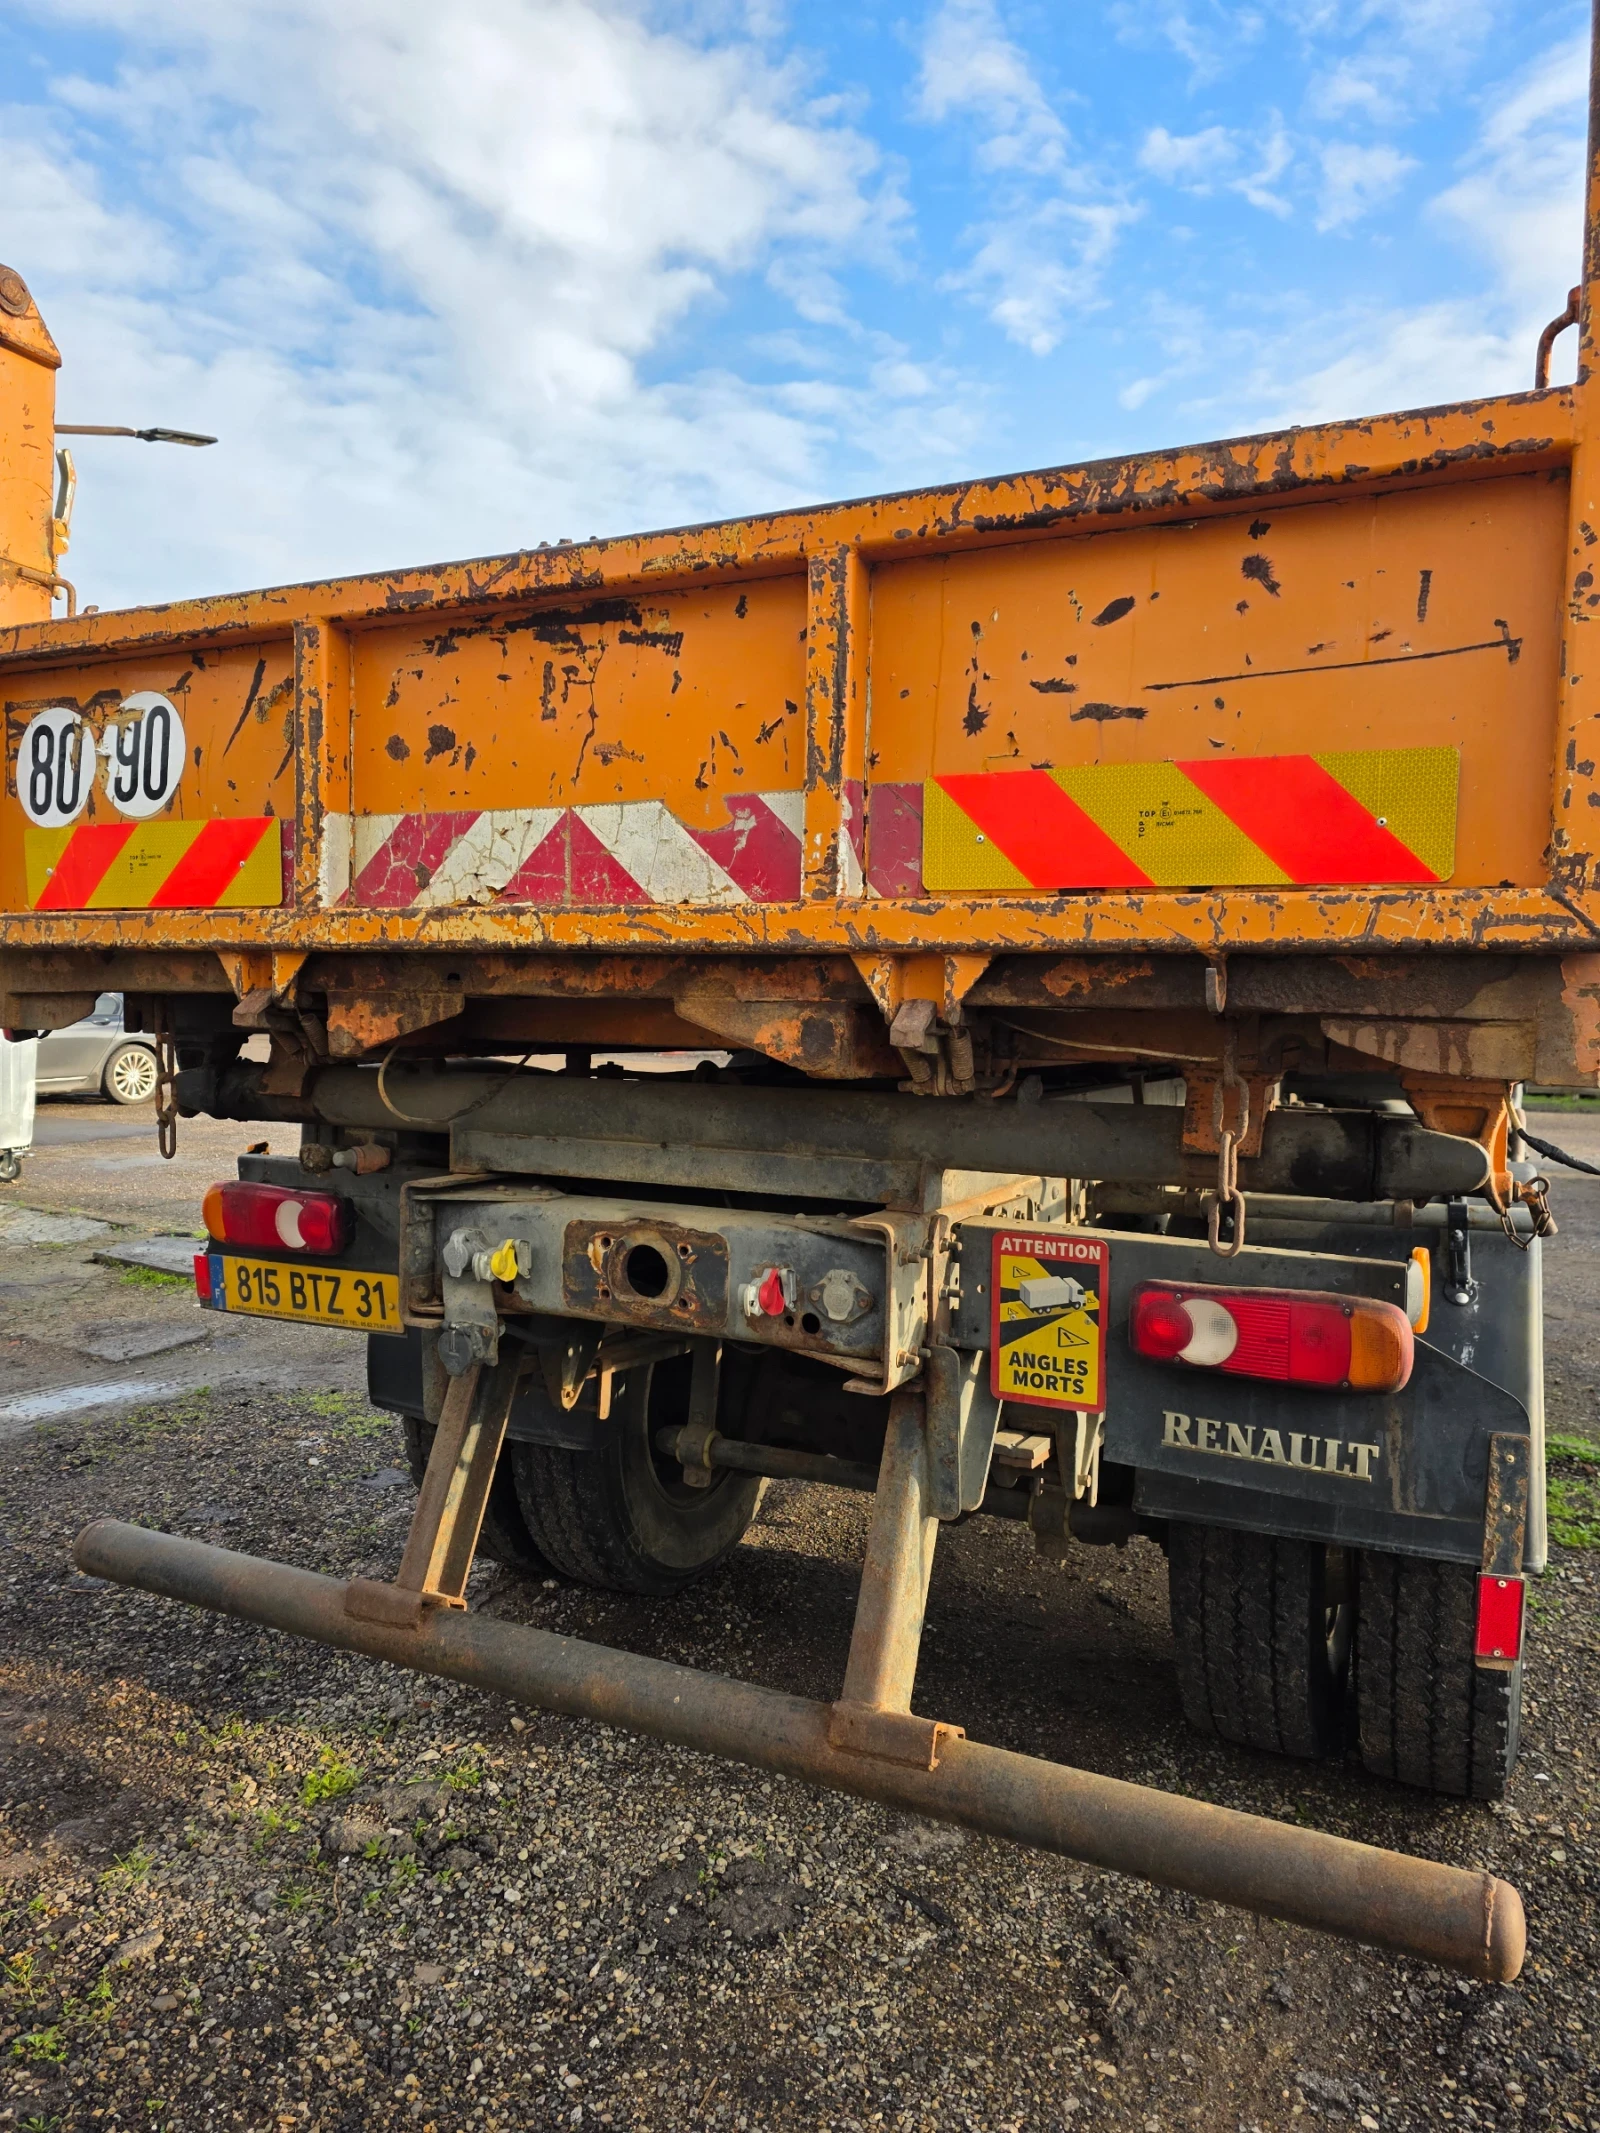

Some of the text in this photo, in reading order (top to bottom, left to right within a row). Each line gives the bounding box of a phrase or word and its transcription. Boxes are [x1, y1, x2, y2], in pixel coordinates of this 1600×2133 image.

[113, 705, 171, 803] 90
[29, 722, 83, 816] 80
[1139, 810, 1156, 818] TOP
[1001, 1237, 1101, 1260] ATTENTION
[215, 1288, 221, 1299] F
[237, 1265, 387, 1321] 815 BTZ 31
[1008, 1351, 1089, 1376] ANGLES
[1013, 1370, 1084, 1394] MORTS
[1161, 1410, 1380, 1483] RENAULT
